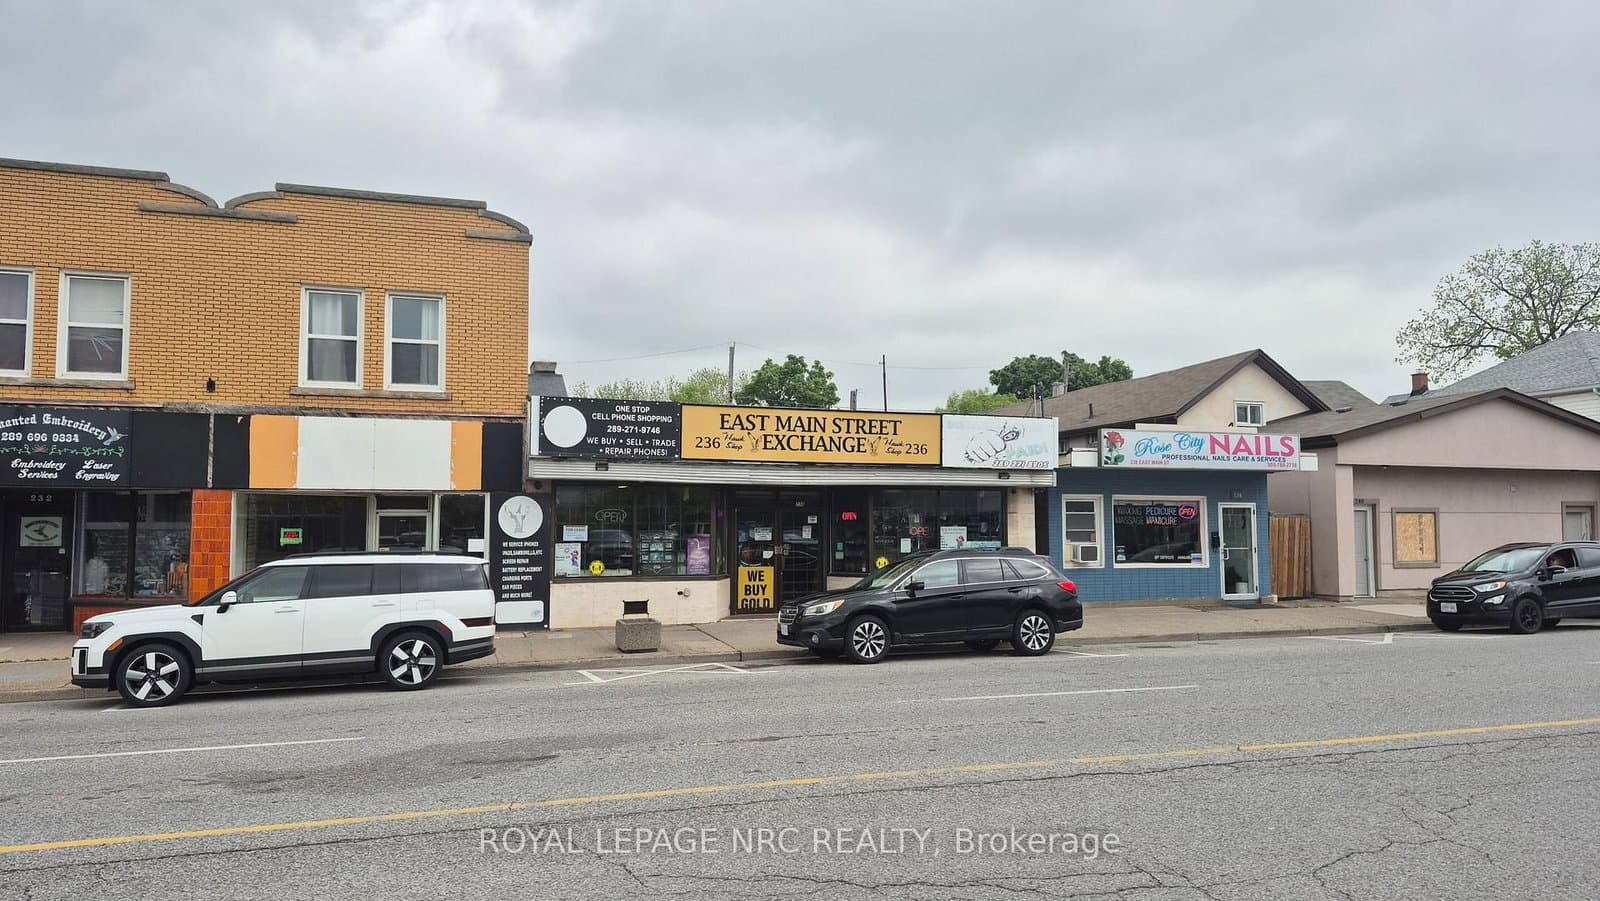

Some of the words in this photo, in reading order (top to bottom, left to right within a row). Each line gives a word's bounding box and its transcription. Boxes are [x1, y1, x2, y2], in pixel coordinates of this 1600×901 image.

[615, 405, 630, 413] ONE
[611, 413, 636, 421] PHONE
[42, 413, 107, 440] Embroidery
[720, 413, 770, 431] EAST
[775, 416, 826, 433] MAIN
[832, 417, 902, 435] STREET
[607, 425, 661, 434] 289-271-9746
[1, 432, 22, 441] 289
[27, 433, 47, 442] 696
[601, 437, 617, 445] BUY
[626, 438, 643, 446] SELL
[695, 436, 721, 449] 236
[763, 434, 867, 453] EXCHANGE
[1135, 437, 1171, 457] Rose
[1173, 433, 1205, 454] City
[1209, 433, 1296, 457] NAILS
[605, 447, 632, 455] REPAIR
[905, 443, 928, 455] 236
[1162, 454, 1210, 462] PROFESSIONAL
[11, 458, 67, 470] Embroidery
[82, 459, 113, 469] Laser
[18, 469, 58, 479] Services
[75, 470, 120, 481] Engraving
[30, 494, 53, 502] 232
[1145, 506, 1177, 515] PEDICURE
[1180, 507, 1196, 516] OPEN
[841, 512, 857, 521] OPEN
[1146, 516, 1178, 525] MANICURE
[747, 570, 764, 582] WE
[744, 584, 767, 596] BUY
[741, 598, 770, 608] GOLD
